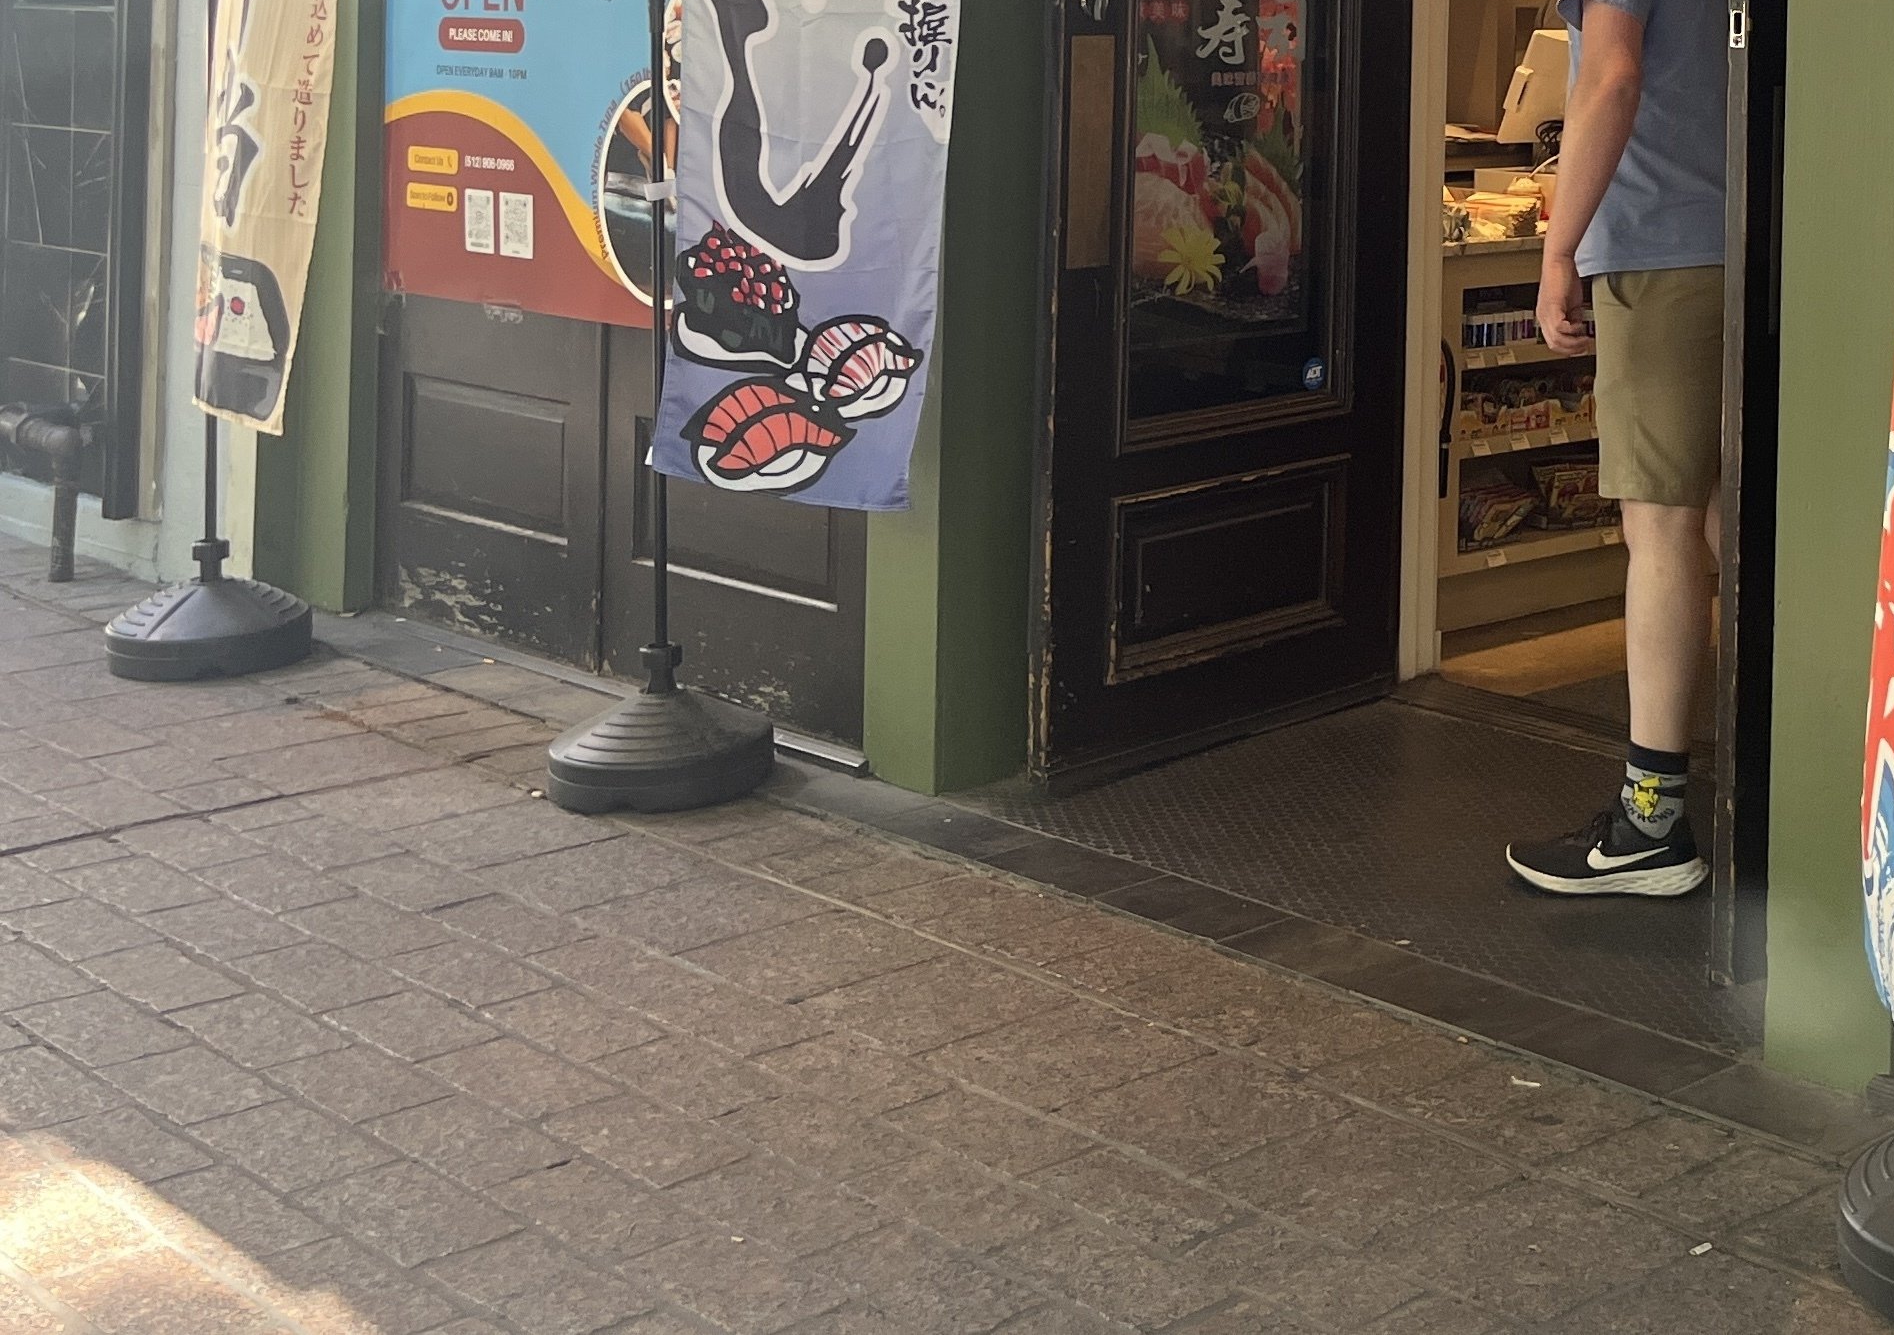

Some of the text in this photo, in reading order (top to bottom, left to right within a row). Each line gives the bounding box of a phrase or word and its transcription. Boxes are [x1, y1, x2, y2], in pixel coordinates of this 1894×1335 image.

[449, 27, 513, 43] PLEASE COME IN!
[436, 64, 453, 76] OPEN
[455, 66, 488, 77] EVERYDAY
